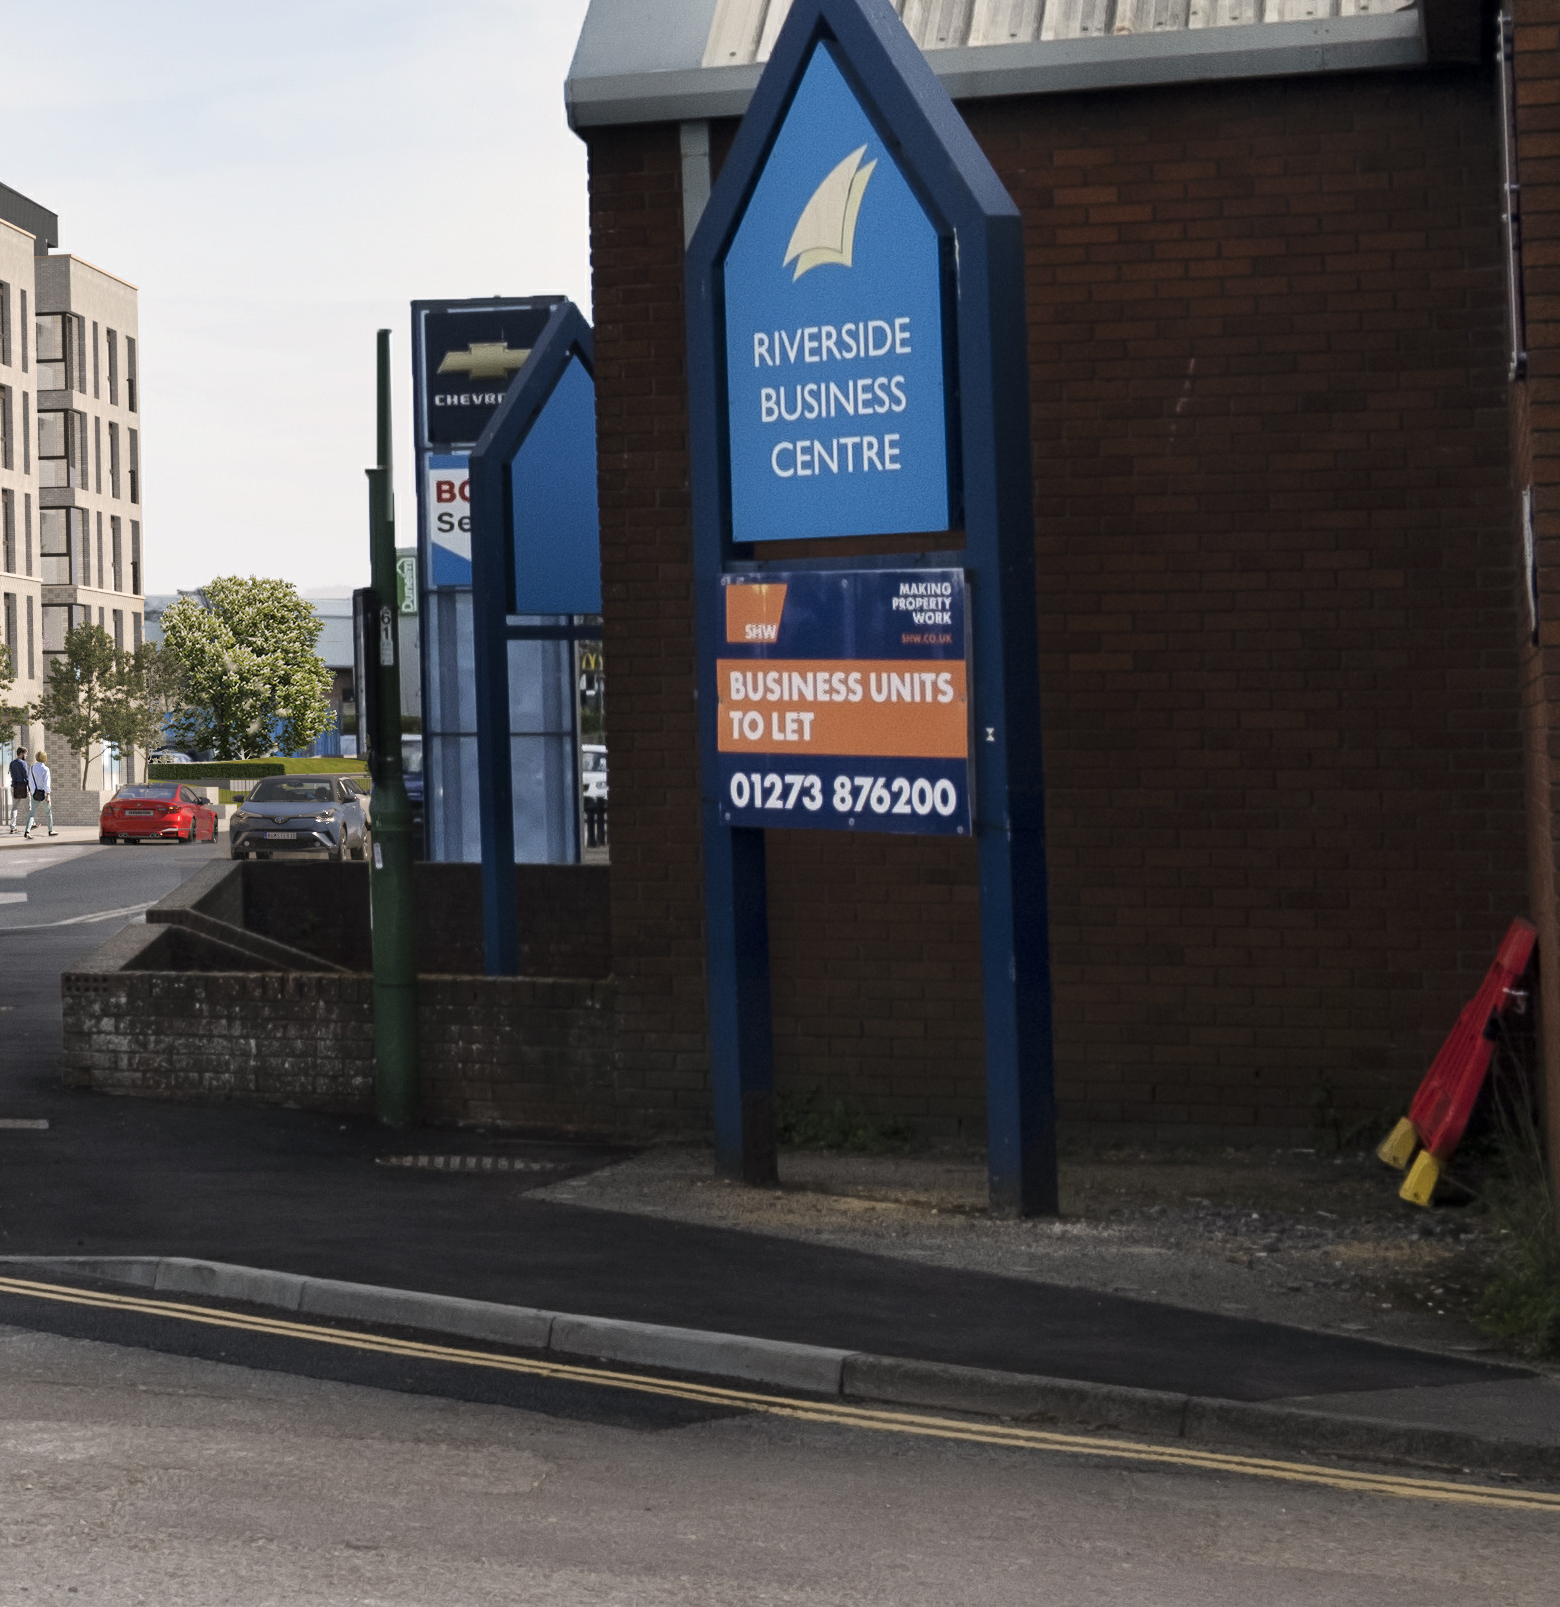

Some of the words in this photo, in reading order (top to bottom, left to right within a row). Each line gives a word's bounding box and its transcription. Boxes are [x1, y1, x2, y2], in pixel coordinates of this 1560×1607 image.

[753, 317, 912, 367] RIVERSIDE
[760, 375, 907, 423] BUSINESS
[771, 433, 902, 478] CENTRE
[892, 596, 952, 610] PROPERTY
[899, 582, 952, 595] MAKING
[745, 623, 777, 640] SHW
[912, 611, 952, 625] WORK
[729, 670, 863, 704] BUSINESS
[869, 671, 954, 704] UNITS
[729, 711, 765, 741] TO
[771, 711, 815, 742] LET
[730, 773, 823, 811] 01273
[832, 775, 957, 816] 876200
